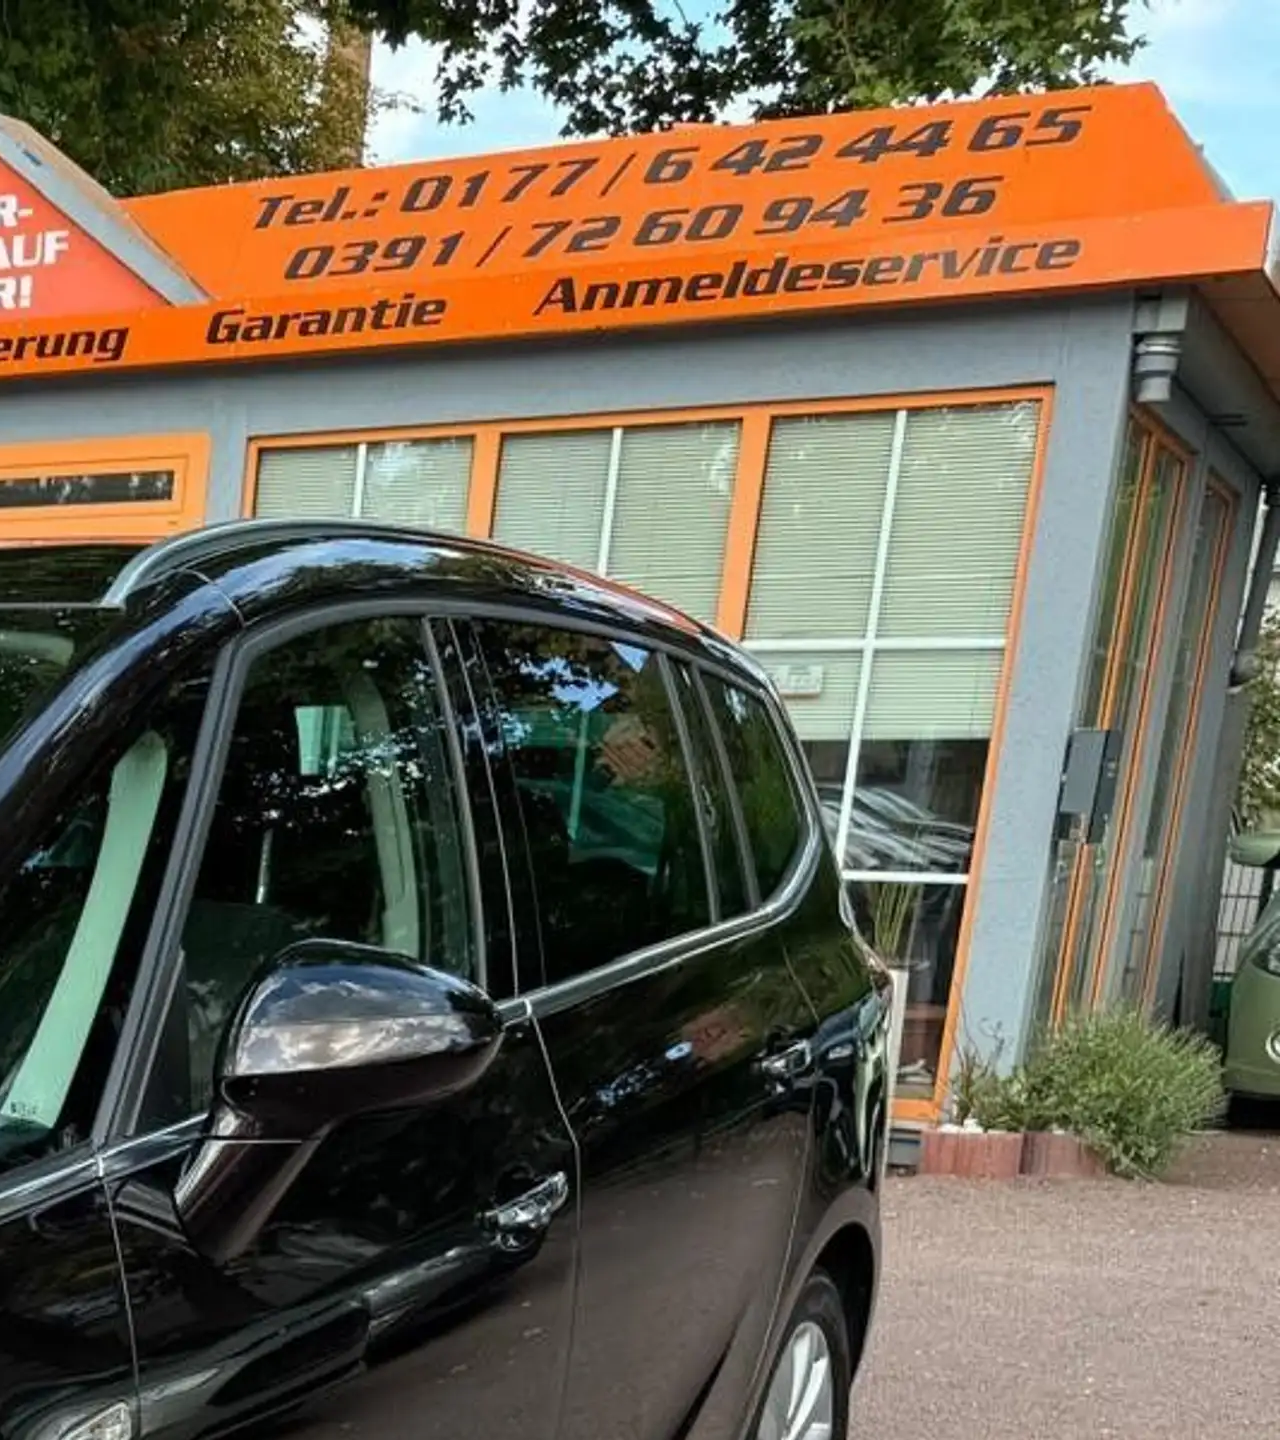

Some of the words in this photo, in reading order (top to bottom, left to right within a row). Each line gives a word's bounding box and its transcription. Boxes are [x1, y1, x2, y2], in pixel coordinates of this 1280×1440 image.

[253, 186, 389, 230] Tel.:
[399, 157, 599, 213] 0177
[283, 230, 465, 281] 0391
[521, 215, 622, 259] 72
[631, 202, 745, 248] 60
[753, 185, 872, 236] 94
[882, 175, 1006, 225] 36
[532, 234, 1083, 317] Anmeldeservice
[204, 291, 448, 346] Garantie
